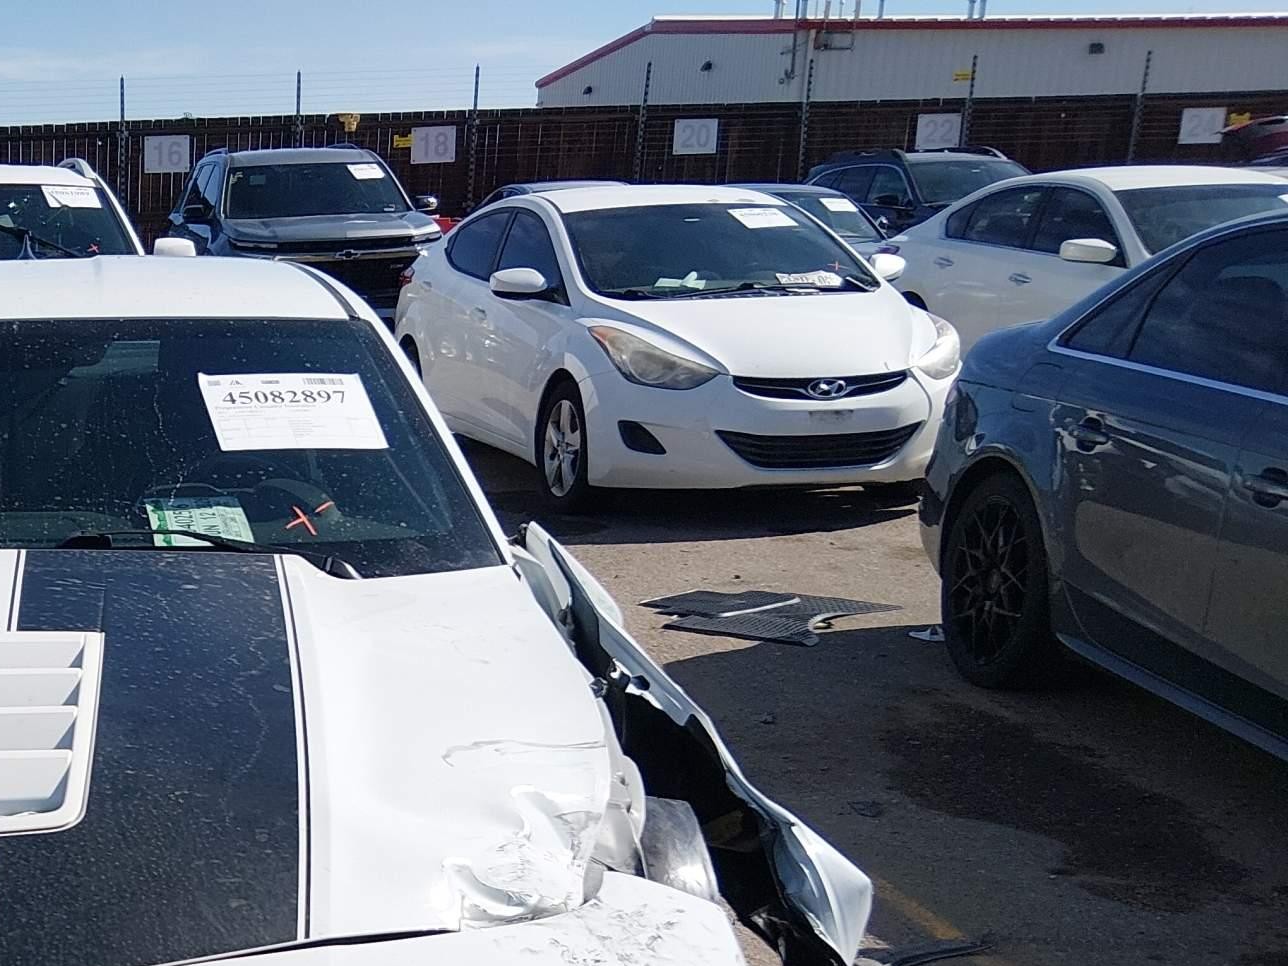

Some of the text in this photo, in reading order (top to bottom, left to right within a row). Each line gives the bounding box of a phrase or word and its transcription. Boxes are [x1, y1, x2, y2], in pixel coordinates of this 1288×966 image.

[679, 123, 710, 148] 20
[922, 118, 954, 144] 22
[152, 140, 183, 167] 16
[420, 131, 449, 158] 18
[222, 389, 346, 405] 45082897
